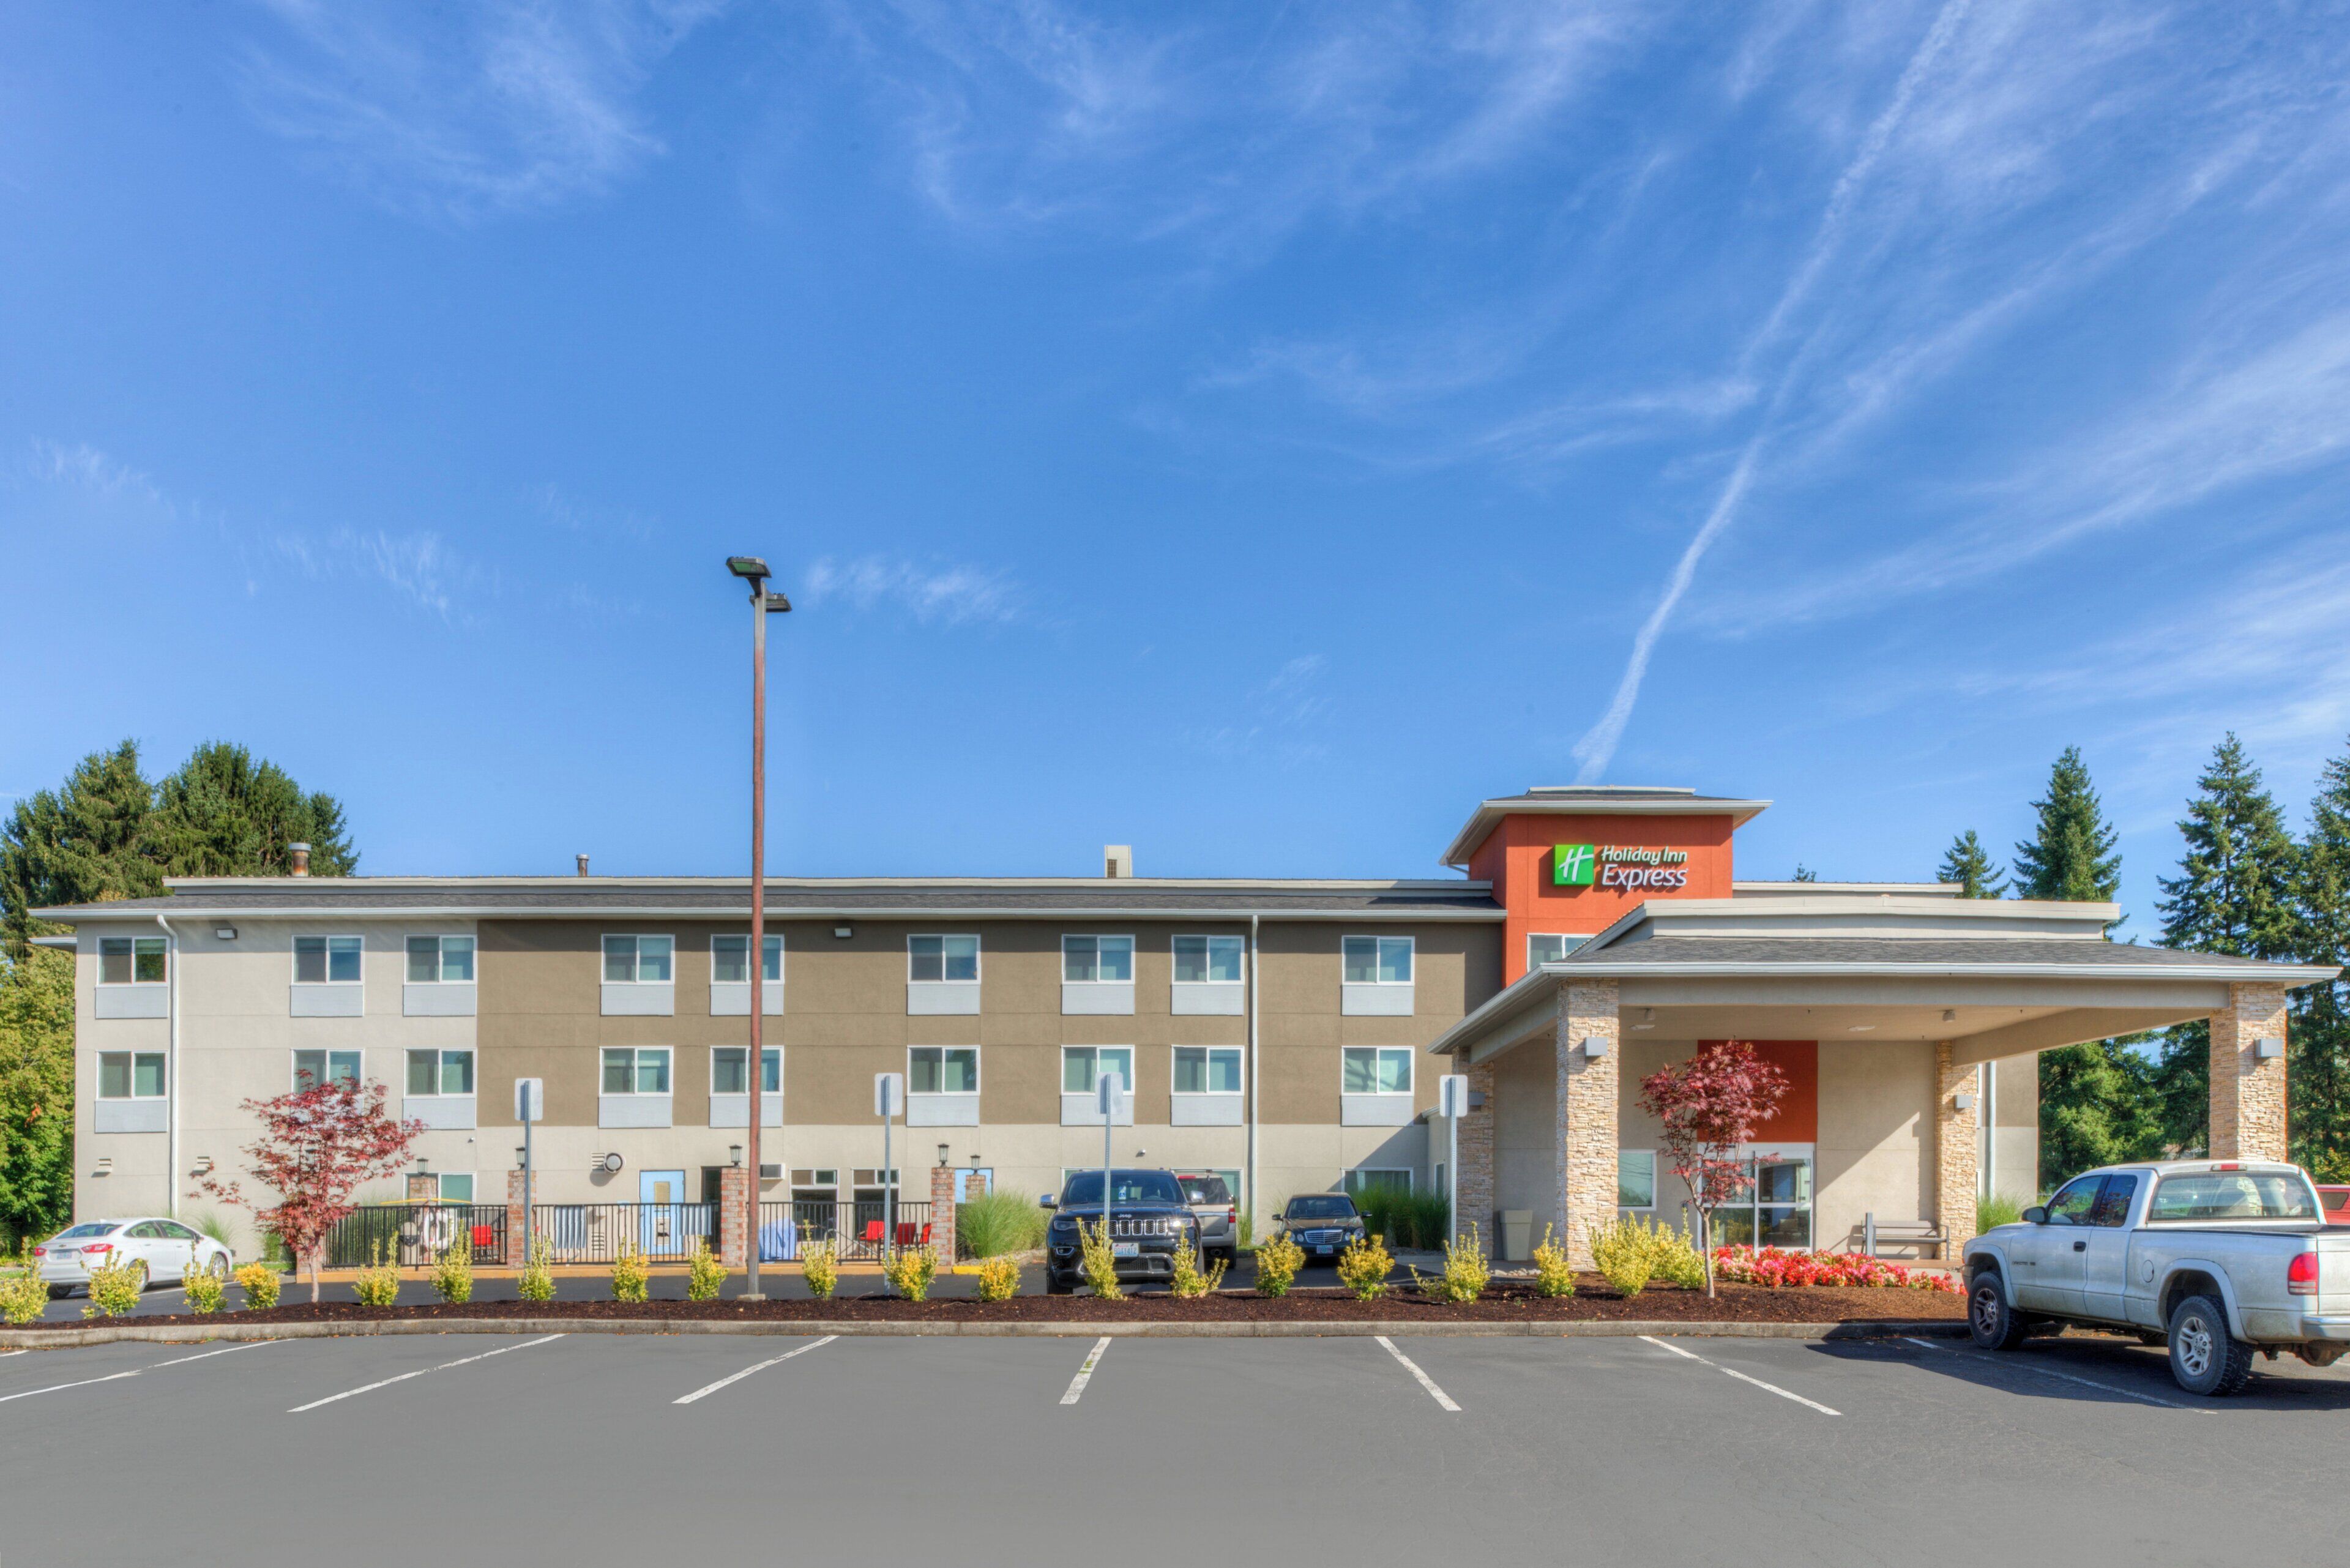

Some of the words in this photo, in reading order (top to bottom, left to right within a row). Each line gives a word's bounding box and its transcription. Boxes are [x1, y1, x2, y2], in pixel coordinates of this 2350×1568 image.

[1601, 845, 1662, 865] Holiday
[1663, 846, 1687, 862] Inn
[1602, 864, 1688, 891] Express
